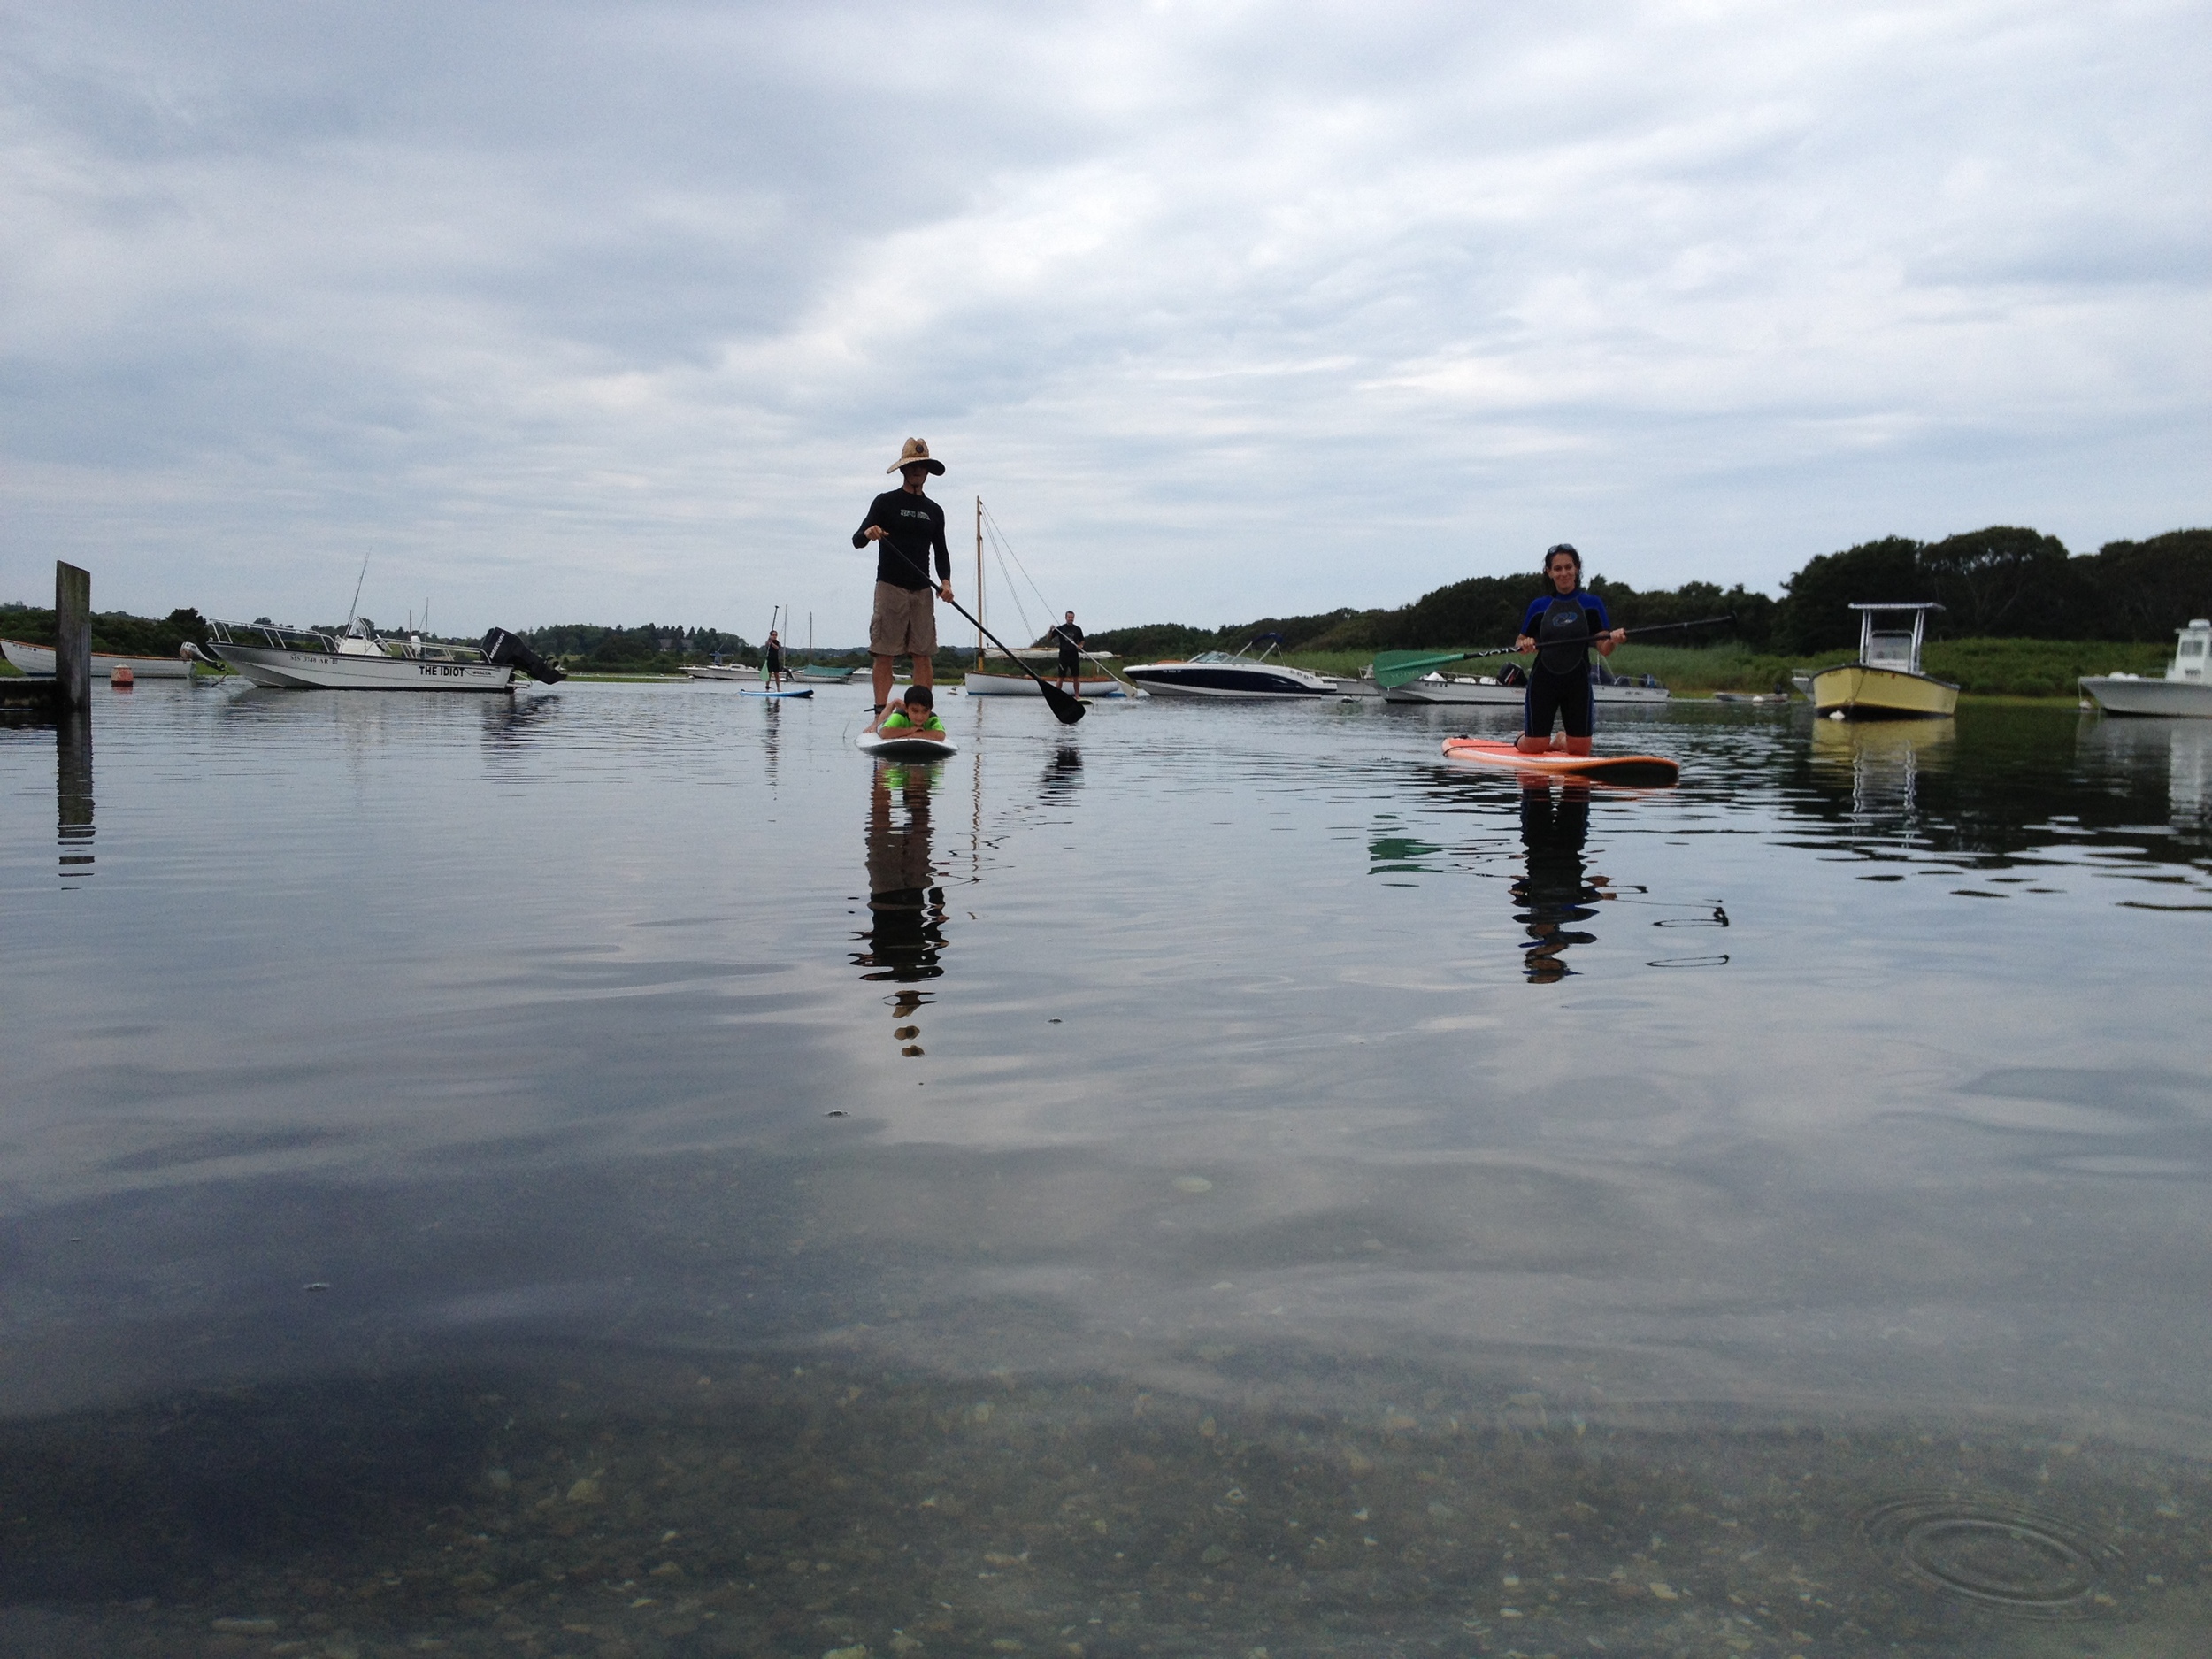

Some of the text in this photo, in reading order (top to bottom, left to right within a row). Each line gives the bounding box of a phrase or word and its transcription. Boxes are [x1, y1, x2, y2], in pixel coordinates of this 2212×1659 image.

[488, 631, 505, 659] MERCURY
[419, 666, 465, 677] THE IDIOT
